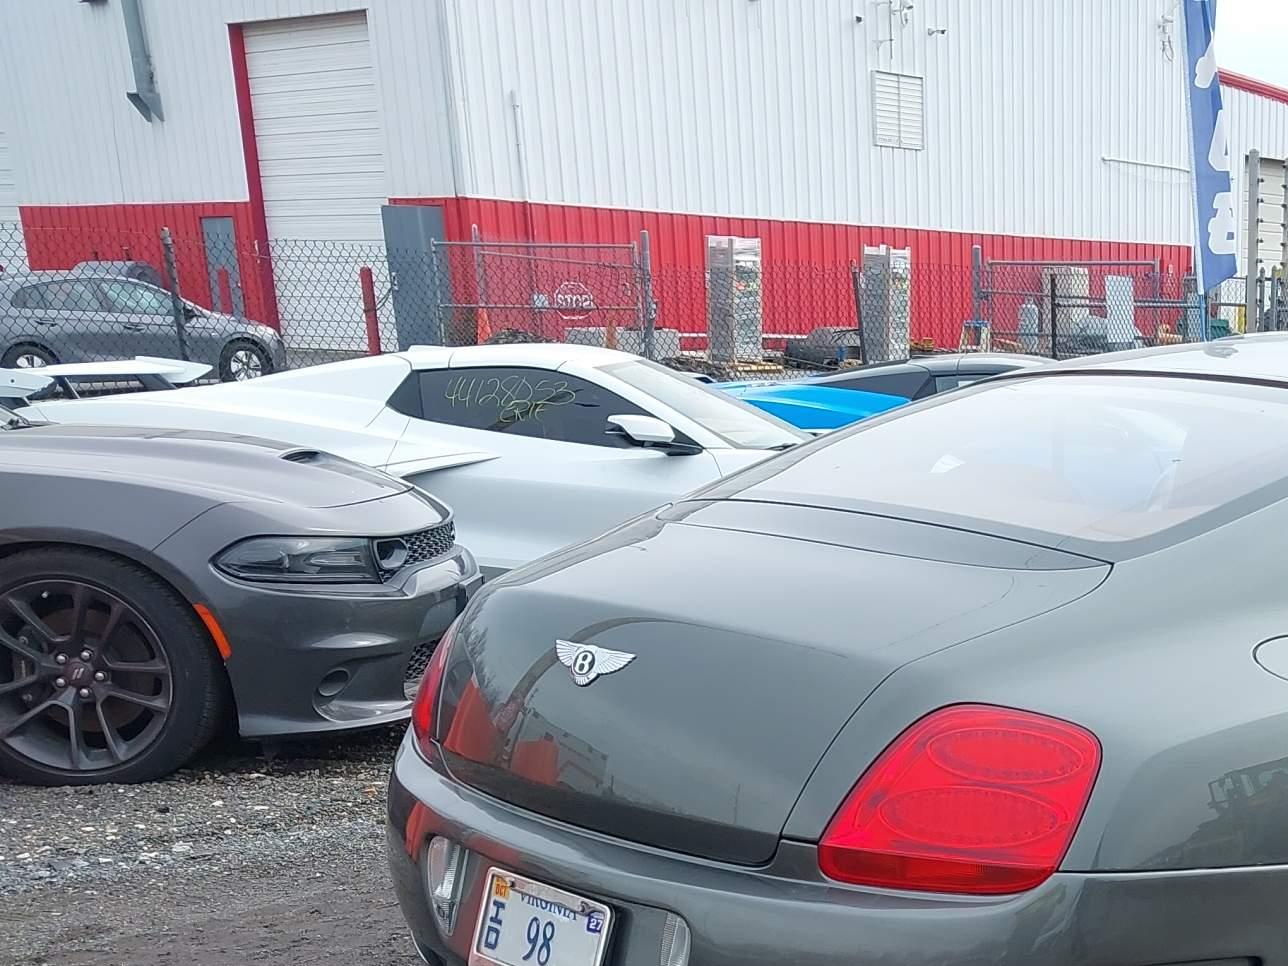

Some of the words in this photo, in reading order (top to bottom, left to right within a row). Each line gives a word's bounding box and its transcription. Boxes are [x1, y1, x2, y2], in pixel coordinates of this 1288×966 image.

[557, 294, 593, 308] STOP
[589, 917, 603, 932] 27
[522, 916, 555, 966] 98
